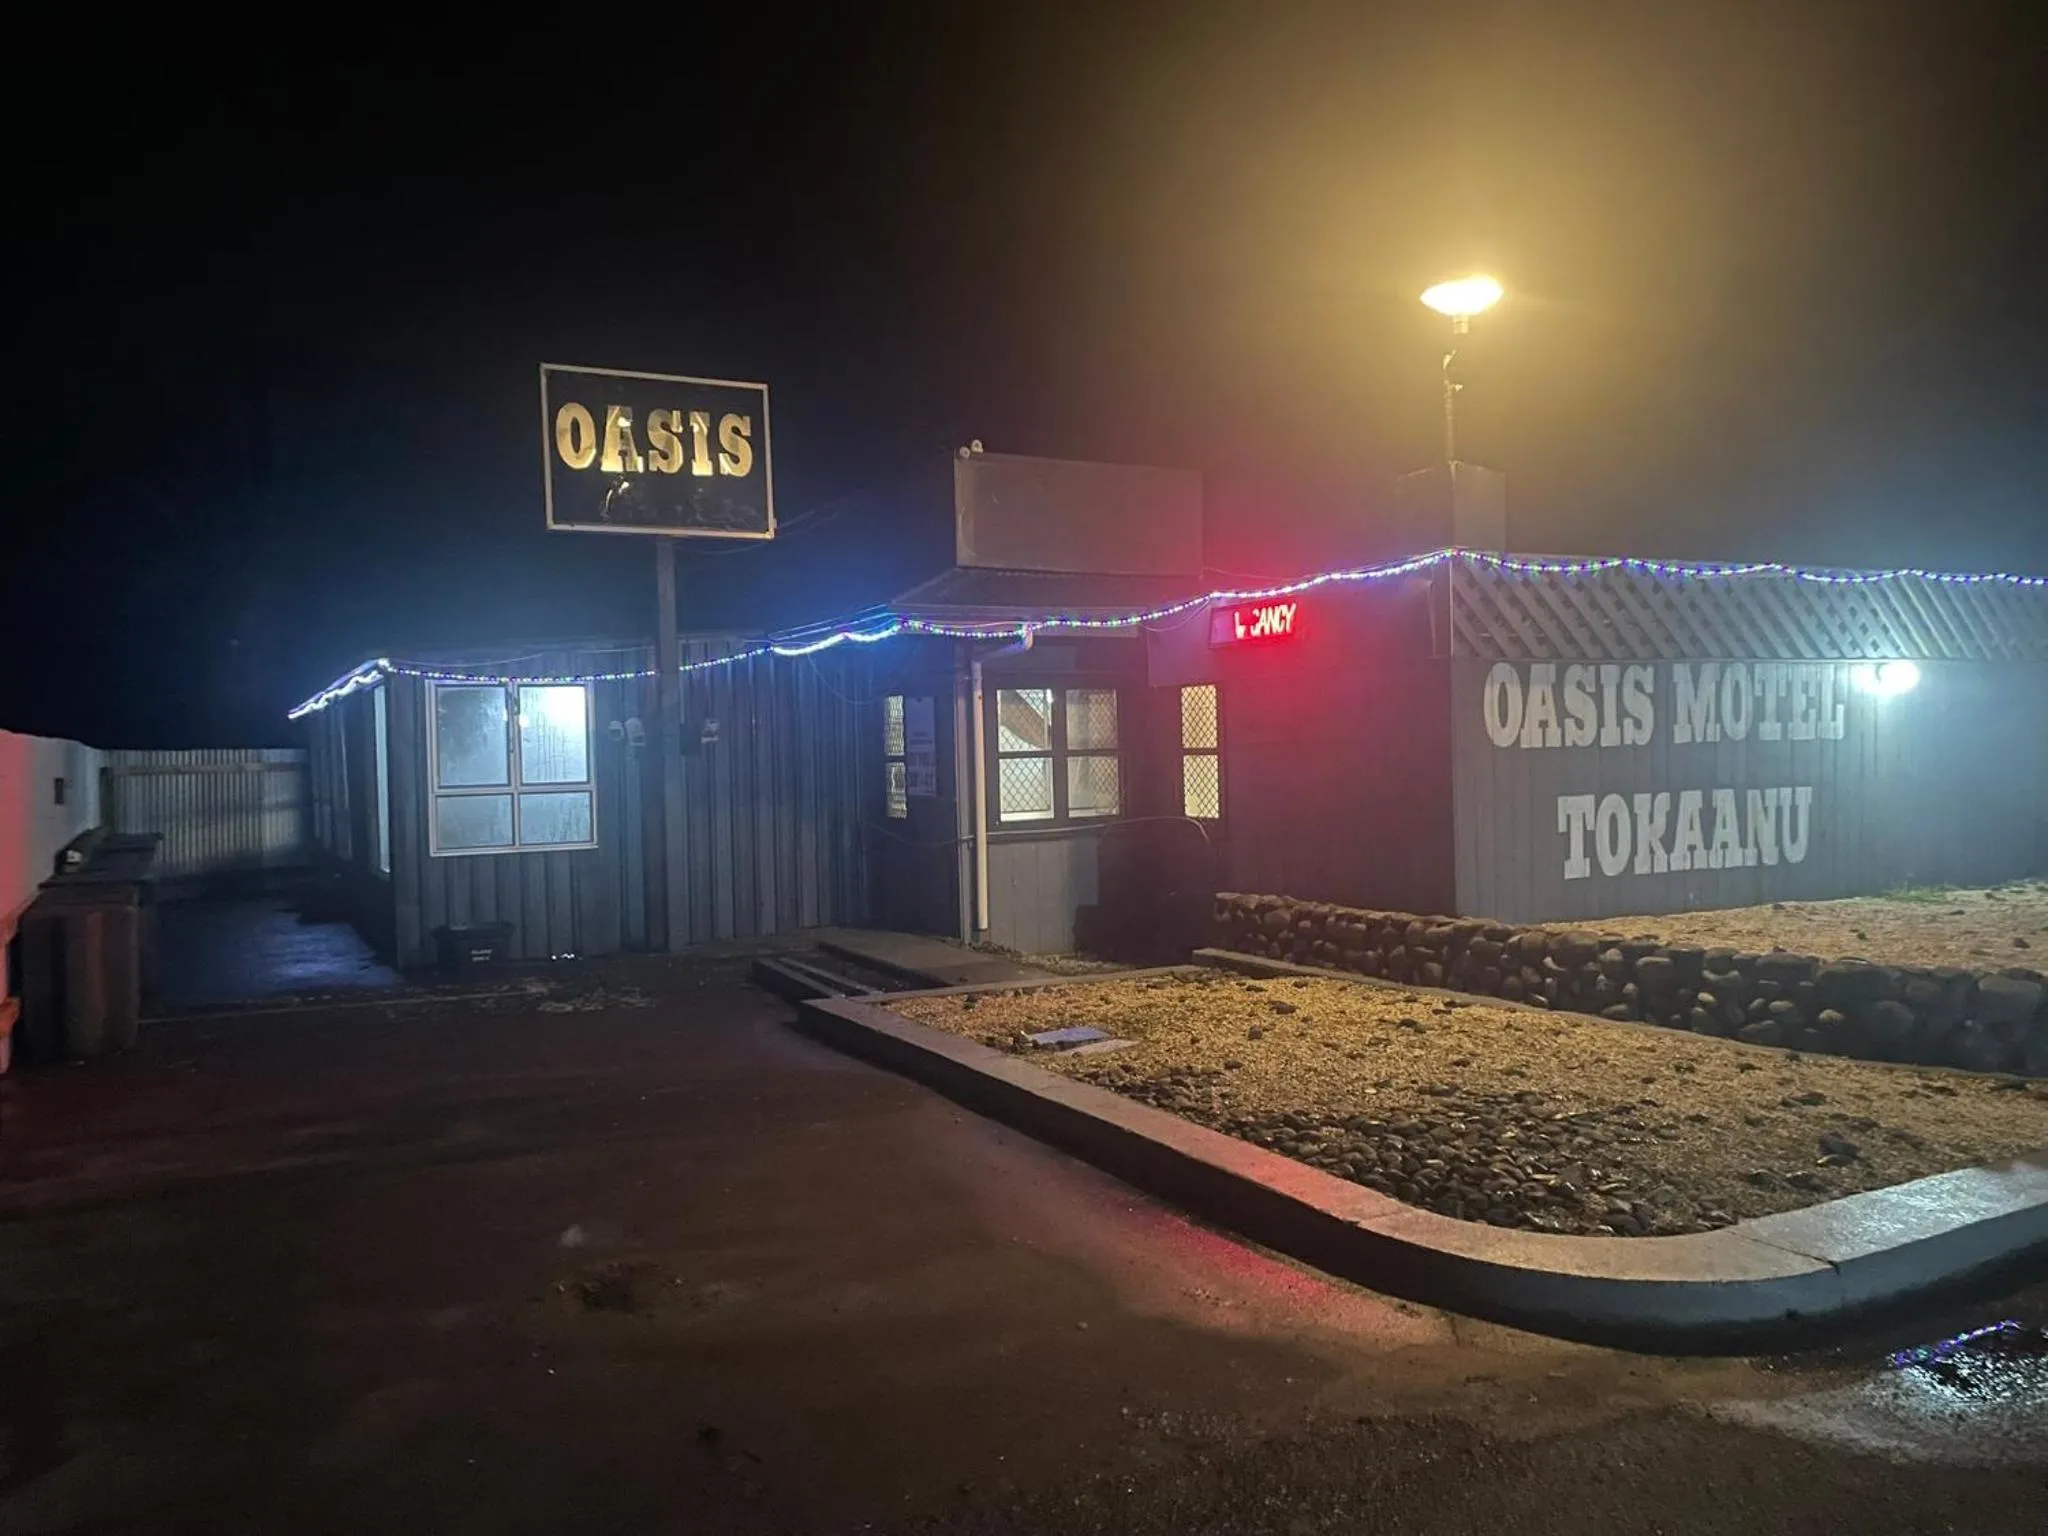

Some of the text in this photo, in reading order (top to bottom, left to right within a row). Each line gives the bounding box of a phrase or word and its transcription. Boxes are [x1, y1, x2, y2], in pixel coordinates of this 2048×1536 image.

[555, 401, 753, 478] OASIS
[1483, 661, 1846, 749] OASIS MOTEL
[1557, 786, 1813, 880] TOKAANU
